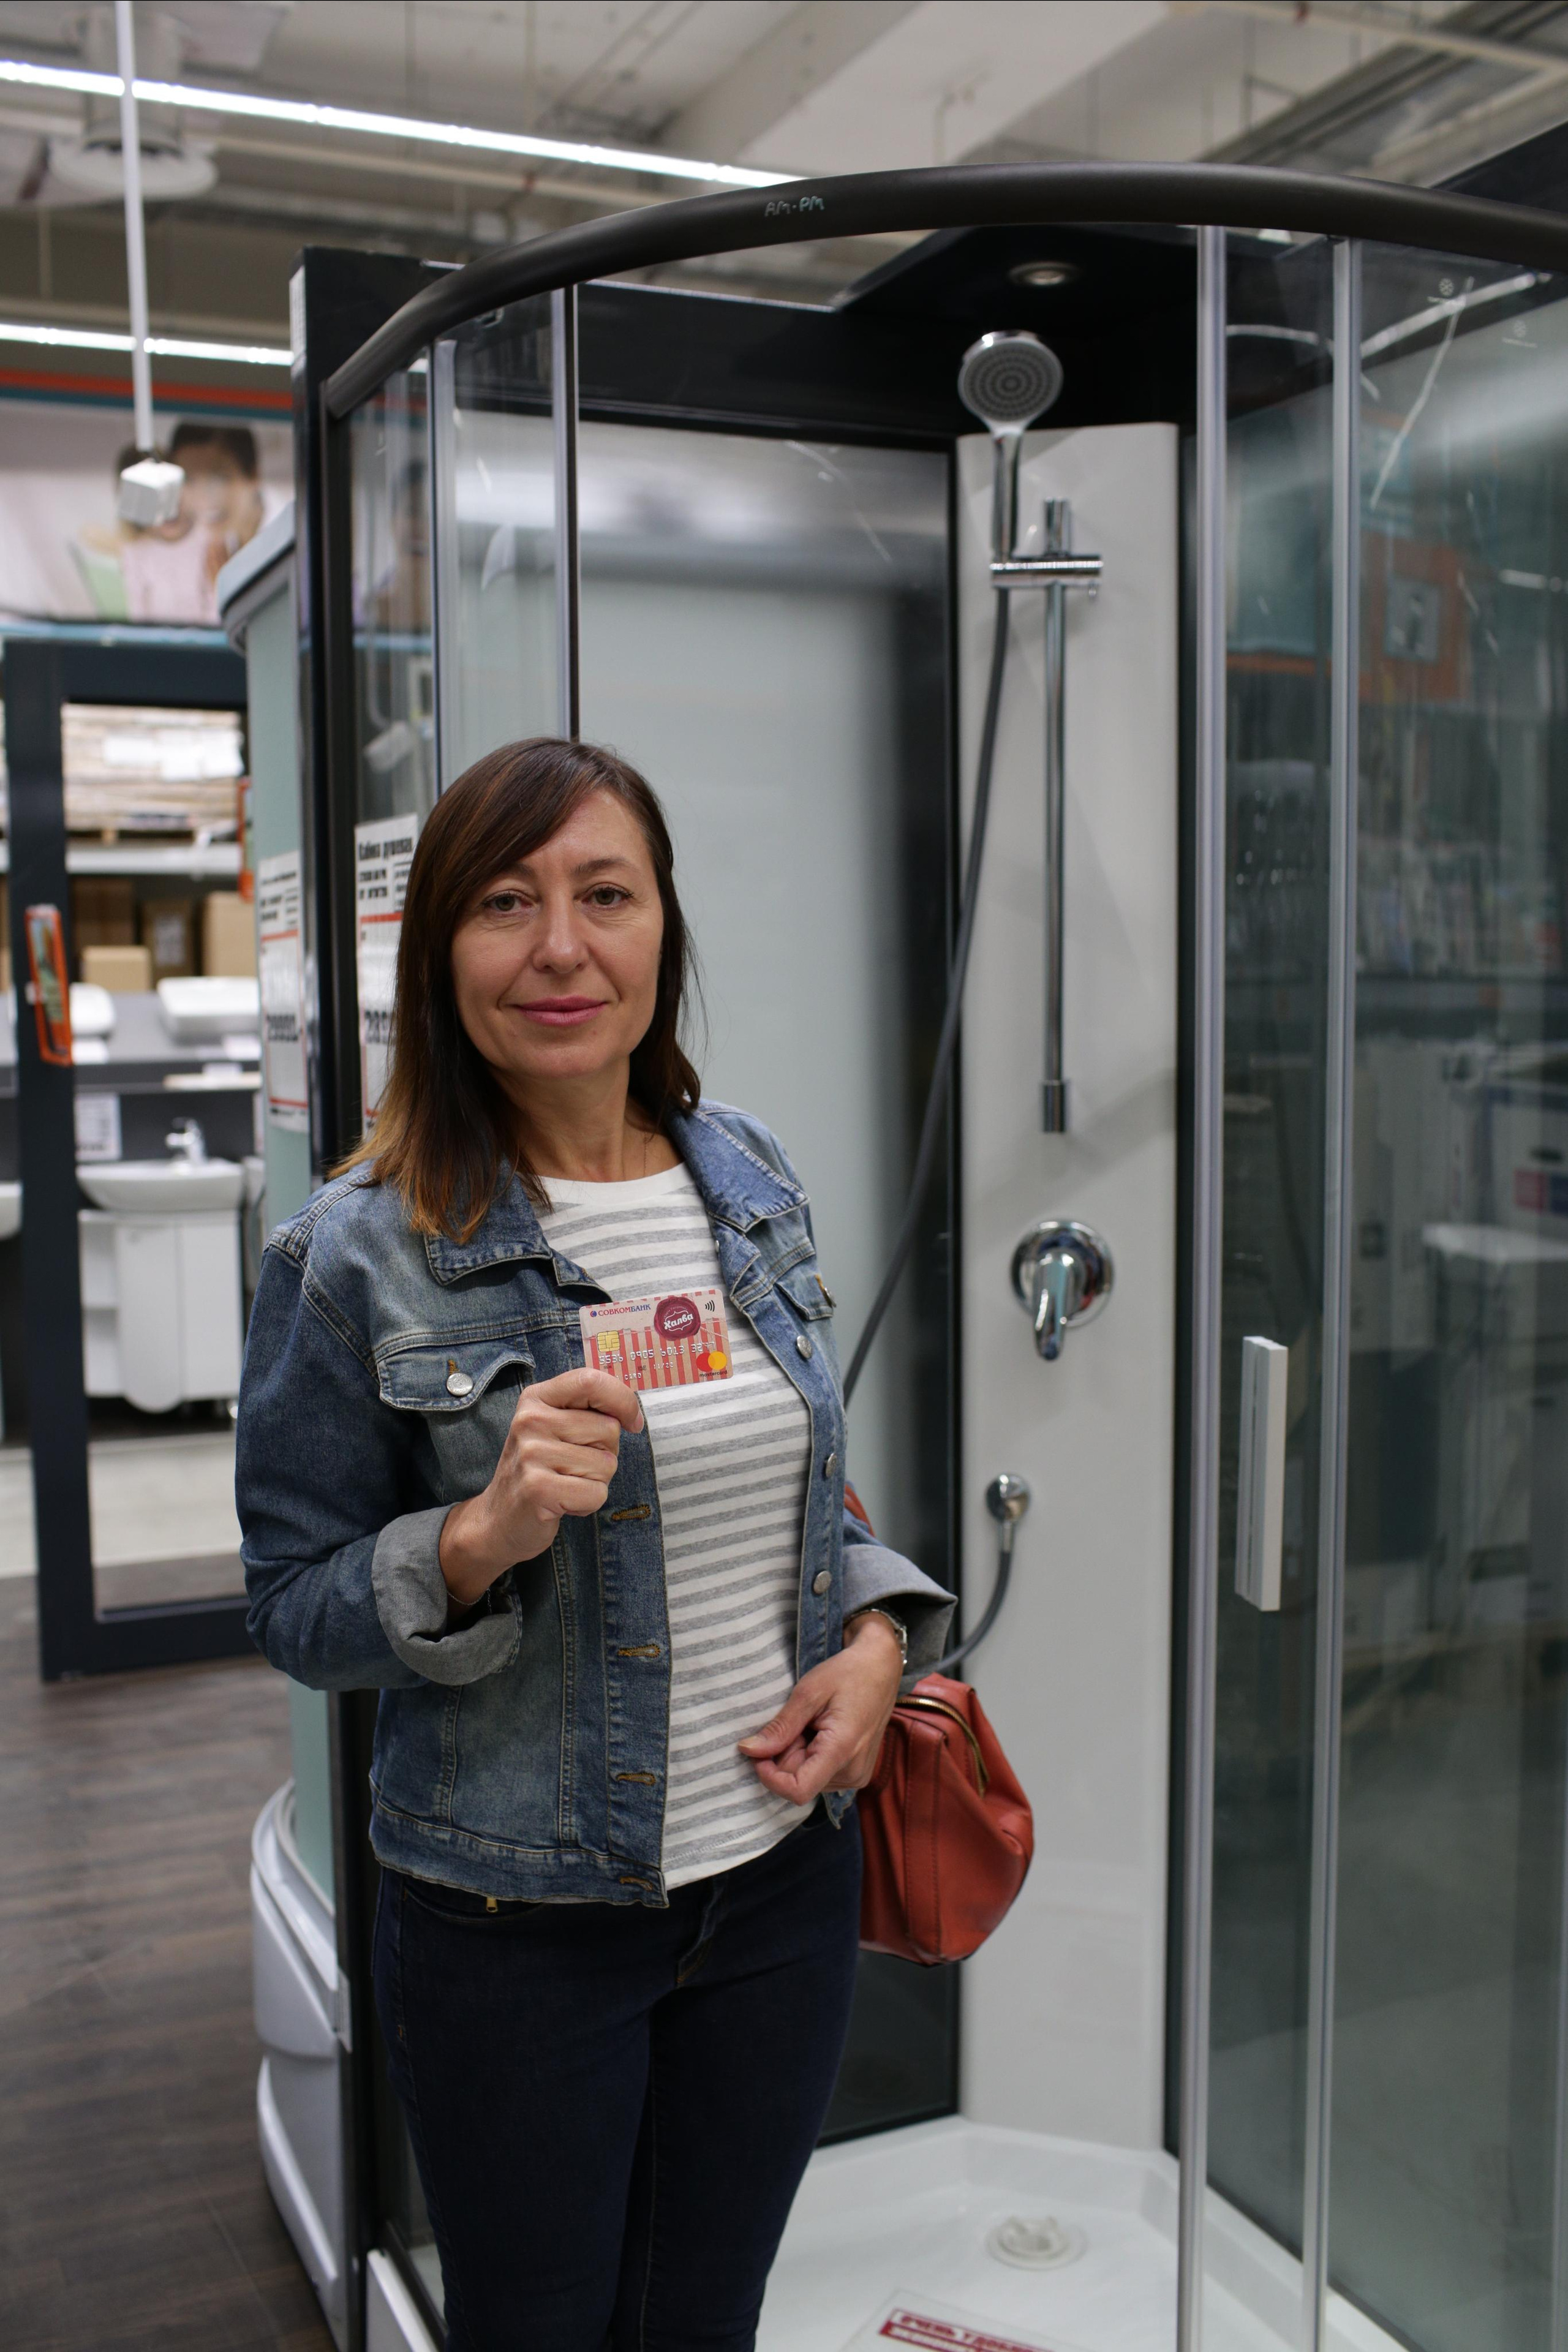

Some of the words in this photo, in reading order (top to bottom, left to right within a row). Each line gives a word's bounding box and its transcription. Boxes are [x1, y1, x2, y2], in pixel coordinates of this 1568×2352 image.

[598, 1304, 650, 1316] СОВКОМБАНК
[663, 1313, 694, 1330] Халва
[598, 1354, 624, 1365] 5536
[630, 1349, 654, 1360] 0905
[660, 1345, 685, 1356] 6013
[691, 1341, 715, 1353] 3277
